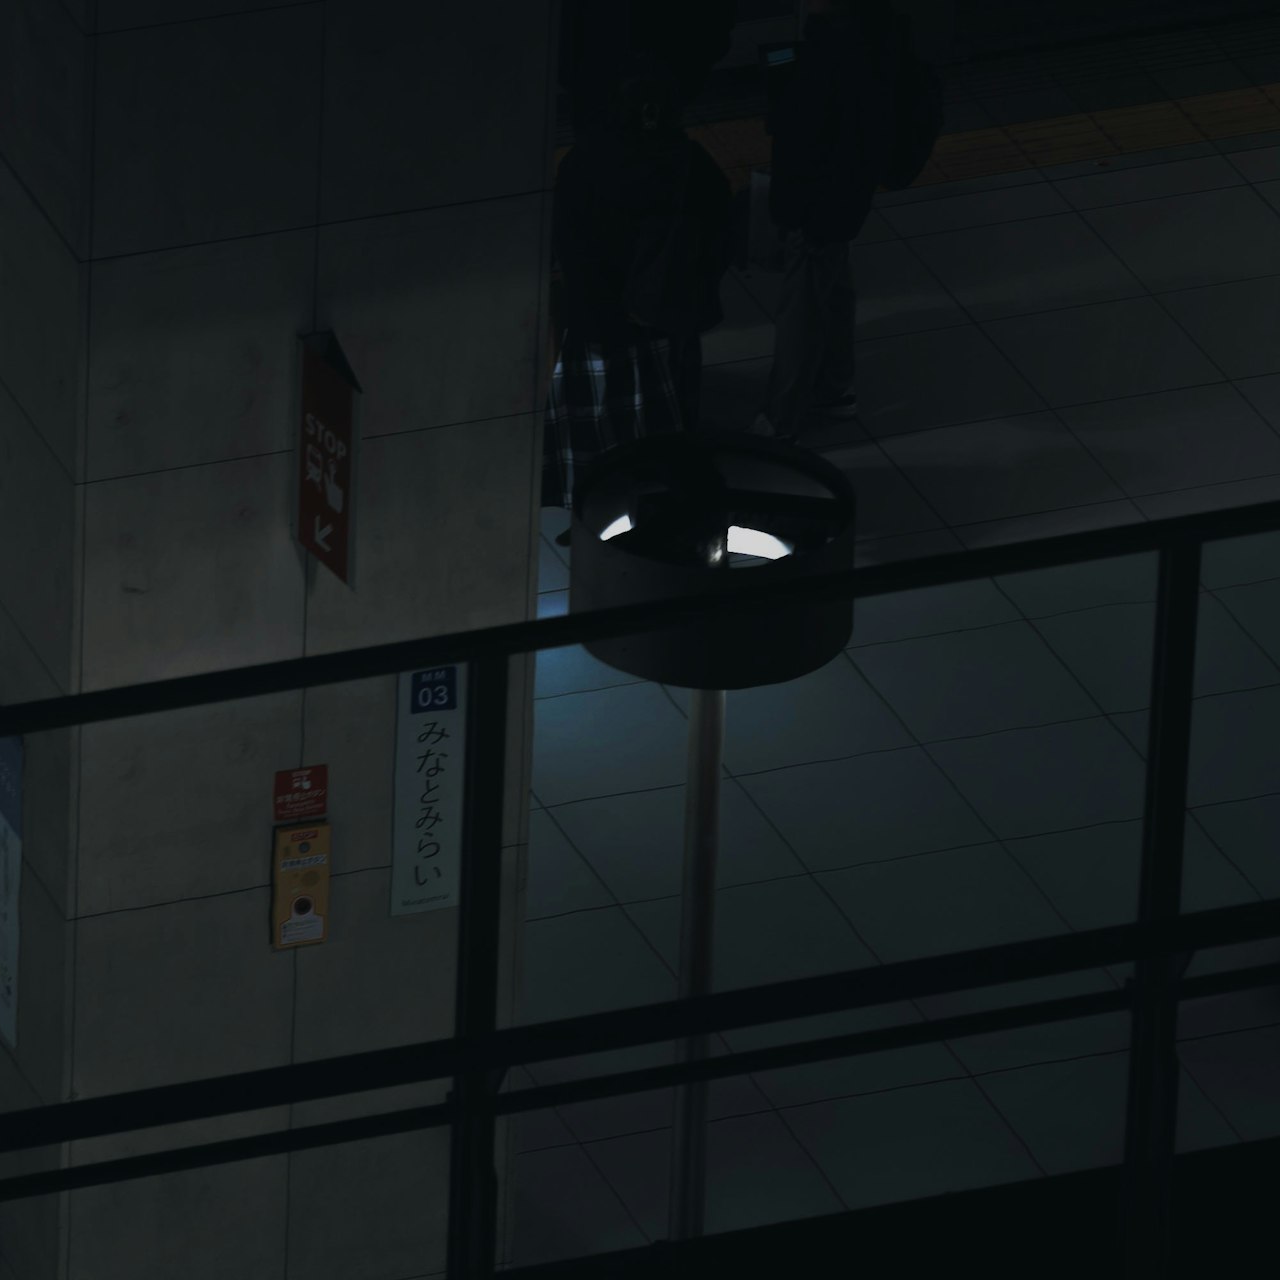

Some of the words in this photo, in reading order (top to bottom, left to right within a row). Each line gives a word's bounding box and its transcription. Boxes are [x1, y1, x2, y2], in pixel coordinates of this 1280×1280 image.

[305, 412, 347, 458] STOP
[418, 685, 448, 707] 03
[415, 722, 450, 886] みなとみらい
